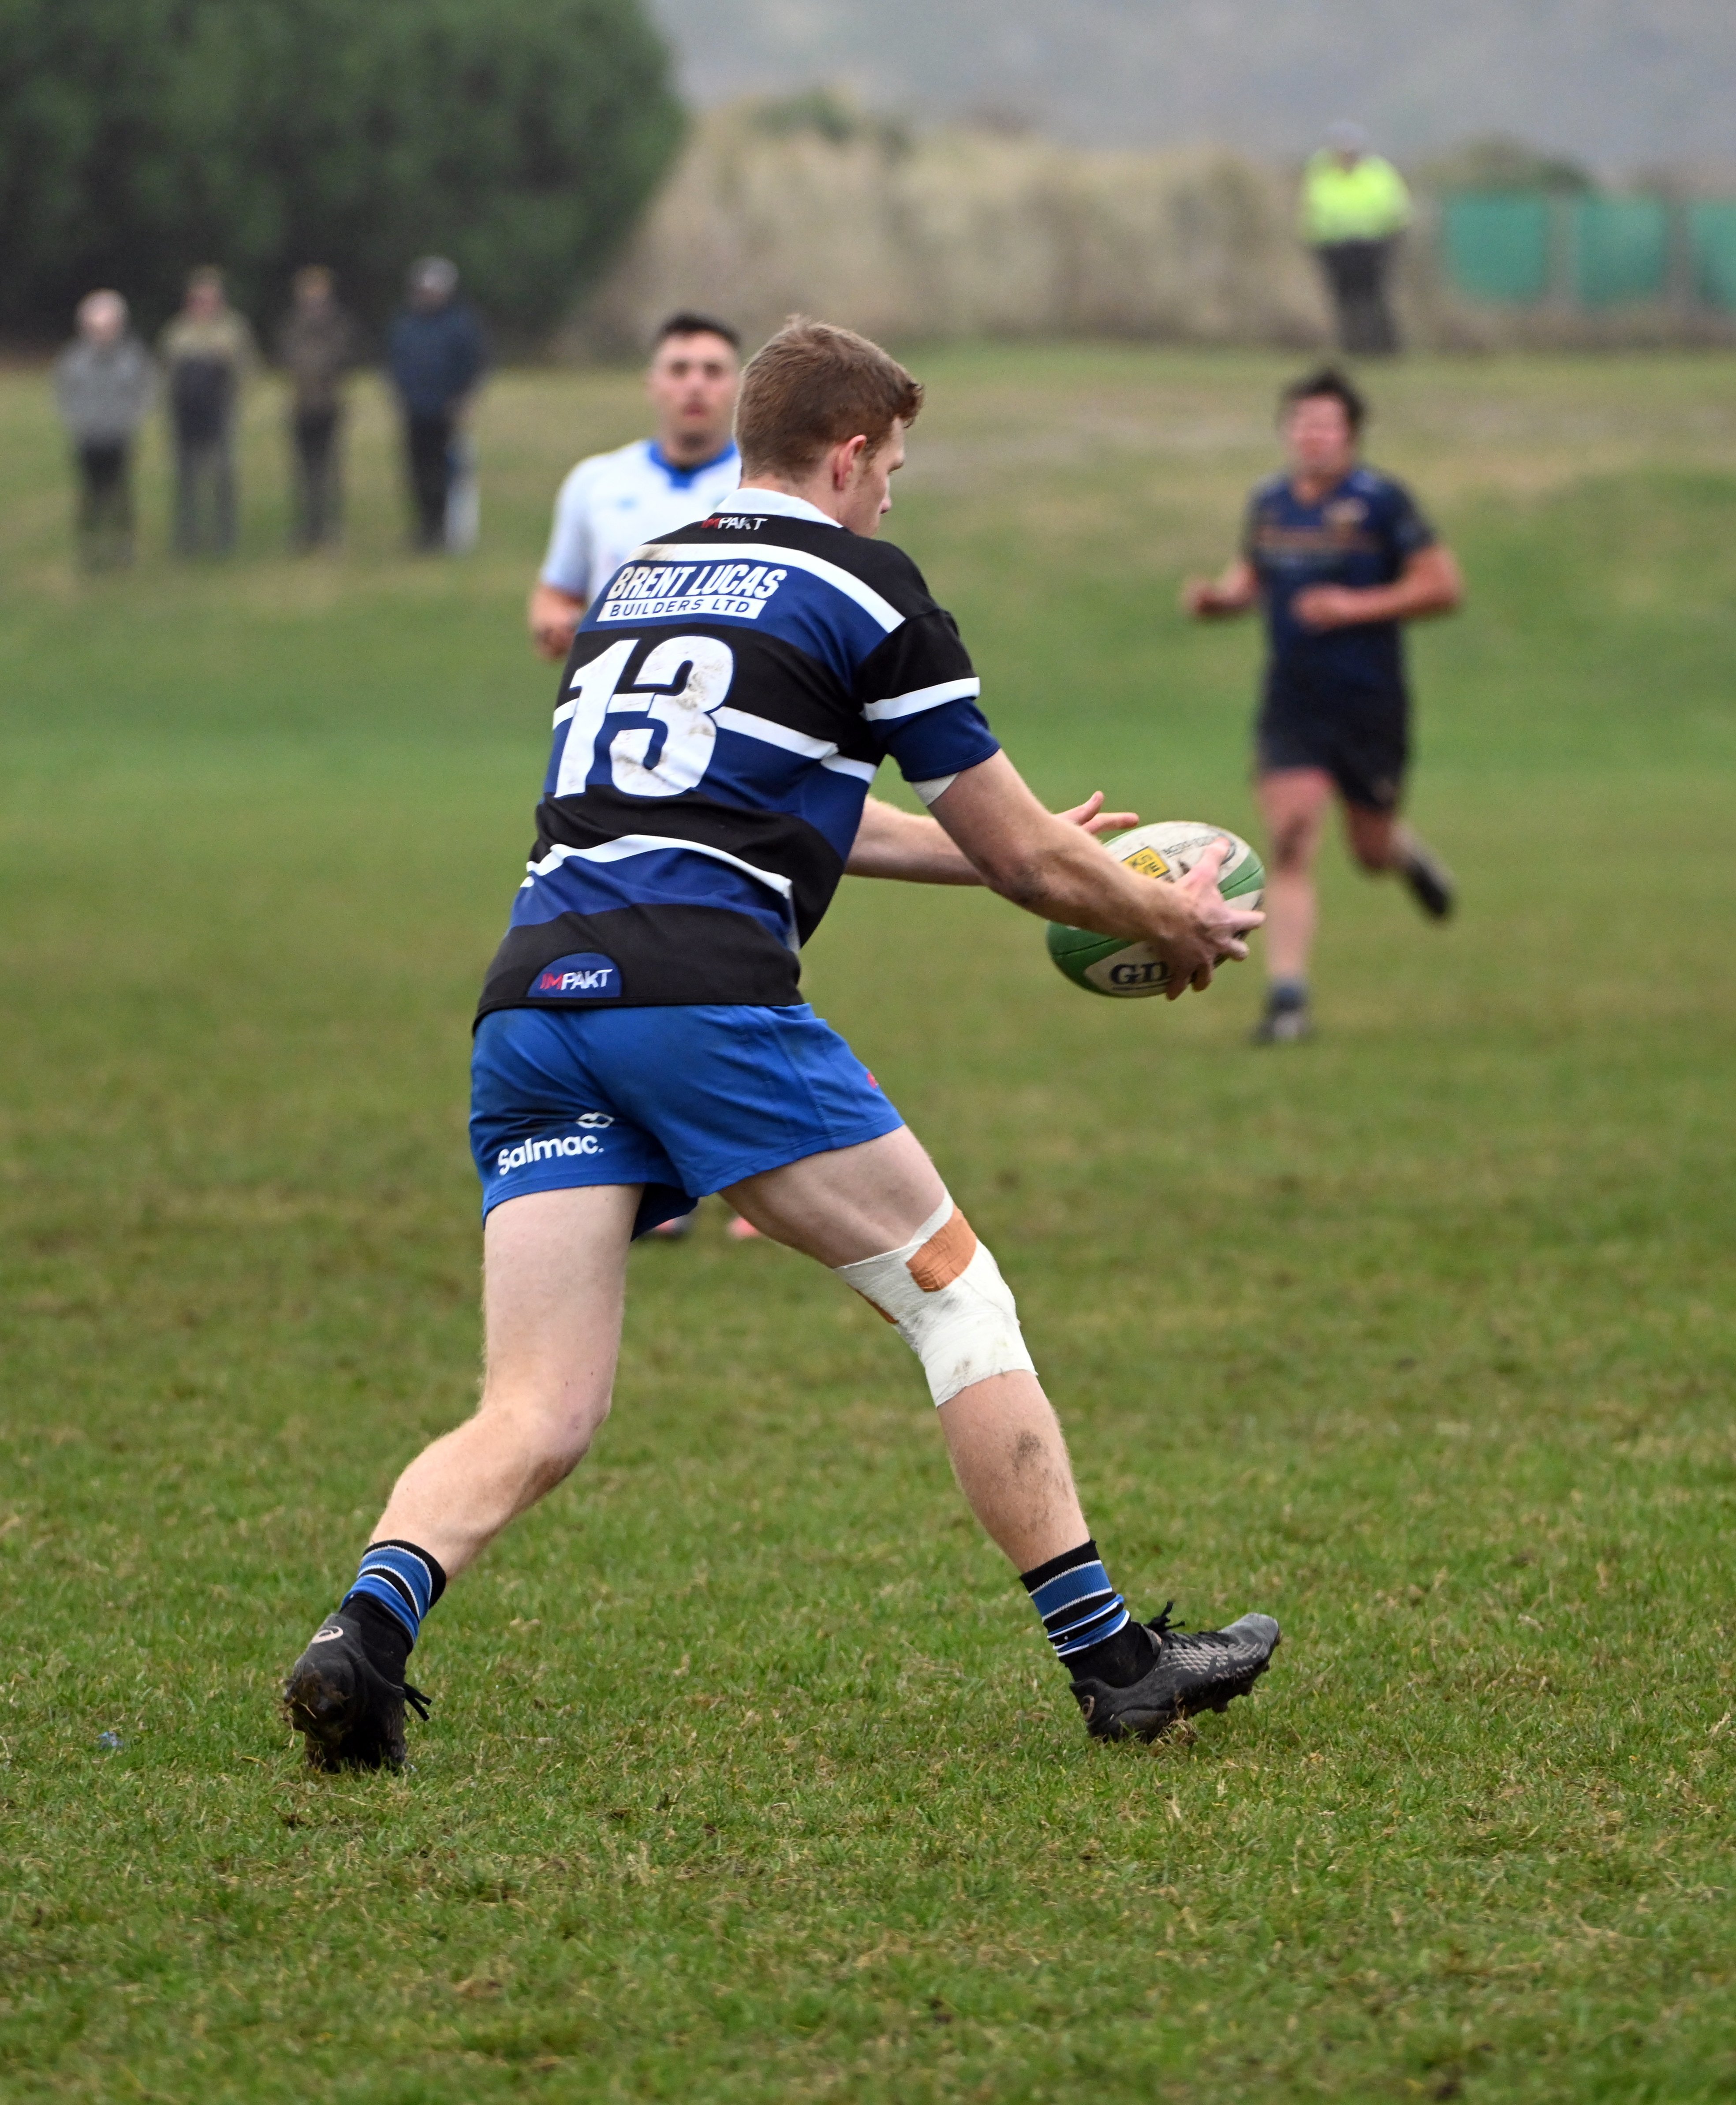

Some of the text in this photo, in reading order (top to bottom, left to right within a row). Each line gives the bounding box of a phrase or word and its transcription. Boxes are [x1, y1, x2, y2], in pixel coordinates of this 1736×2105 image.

[702, 517, 769, 530] IMPAKT
[607, 564, 787, 600] BRENT LUCAS
[610, 599, 749, 616] BUILDERS LTD
[554, 636, 733, 798] 13
[540, 969, 613, 990] IMPAKT
